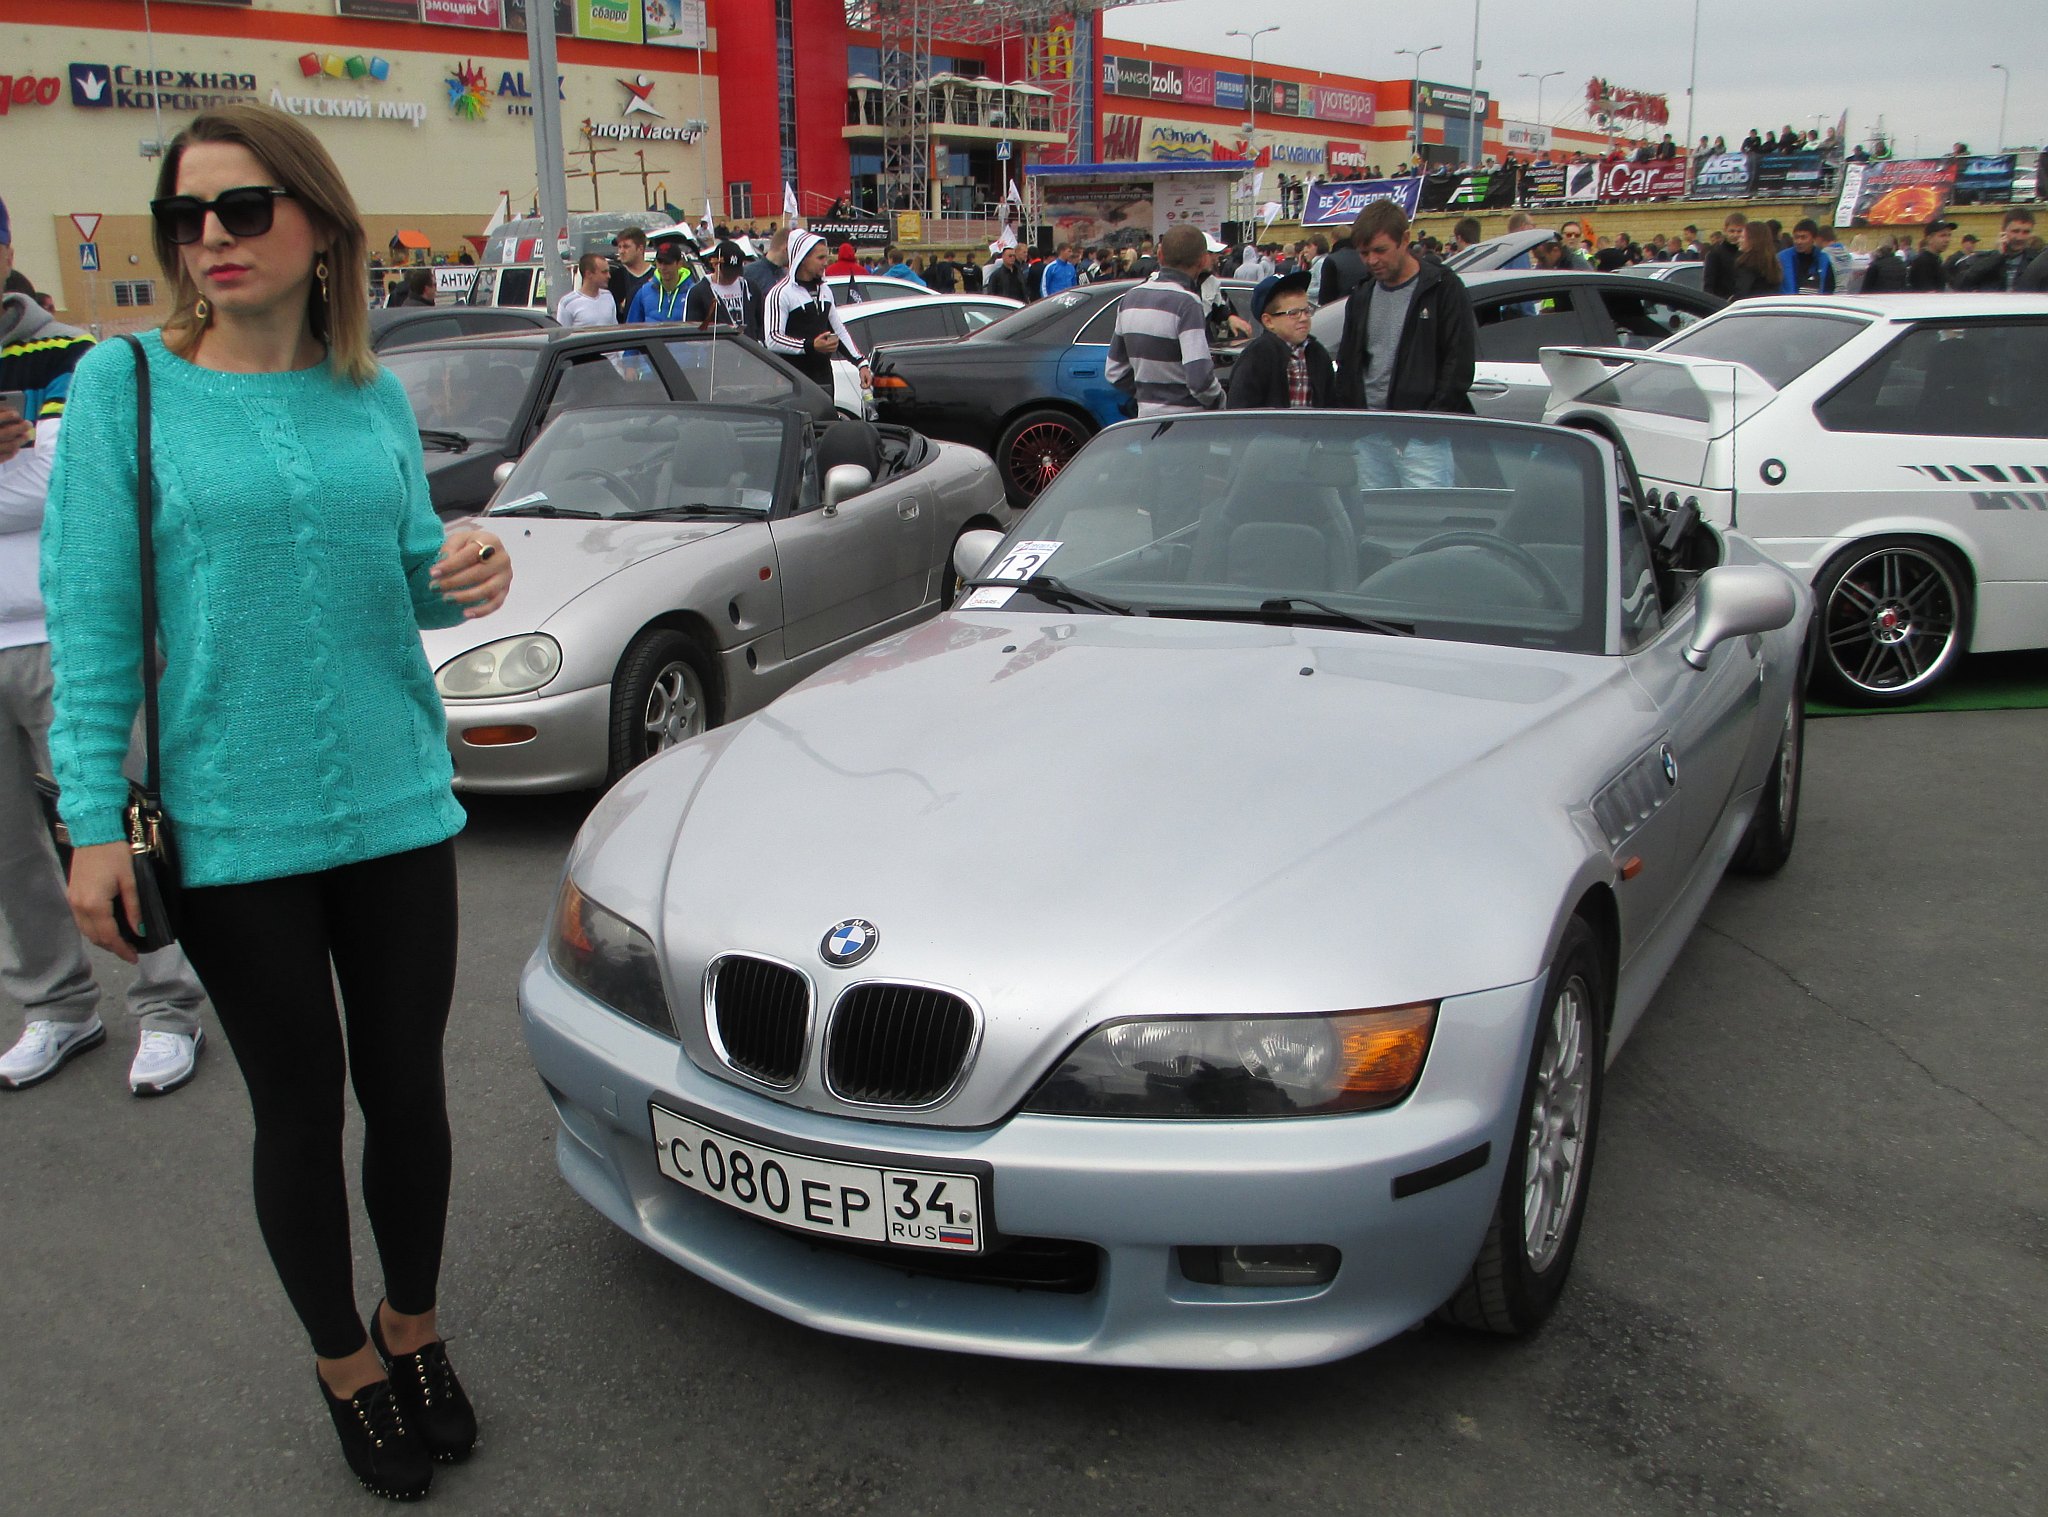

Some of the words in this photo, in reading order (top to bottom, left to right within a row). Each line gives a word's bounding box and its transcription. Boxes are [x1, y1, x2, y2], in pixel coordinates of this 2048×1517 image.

[425, 0, 478, 15] ЭМОЦИЙ!
[592, 7, 627, 22] сбарро
[114, 65, 257, 91] Снежная
[497, 72, 566, 100] AL
[1117, 70, 1150, 85] MANGO
[1152, 70, 1182, 95] zolla
[1187, 70, 1211, 95] kari
[1216, 81, 1244, 93] SAMSUNG
[270, 88, 372, 118] Детский
[379, 101, 428, 127] мир
[1272, 144, 1286, 161] LC
[1600, 164, 1660, 196] iCar
[1392, 185, 1408, 203] 34
[810, 223, 889, 233] HANNIBAL
[994, 554, 1041, 580] 13
[834, 919, 875, 936] BMW
[892, 1177, 954, 1225] 34
[892, 1222, 937, 1240] RUS
